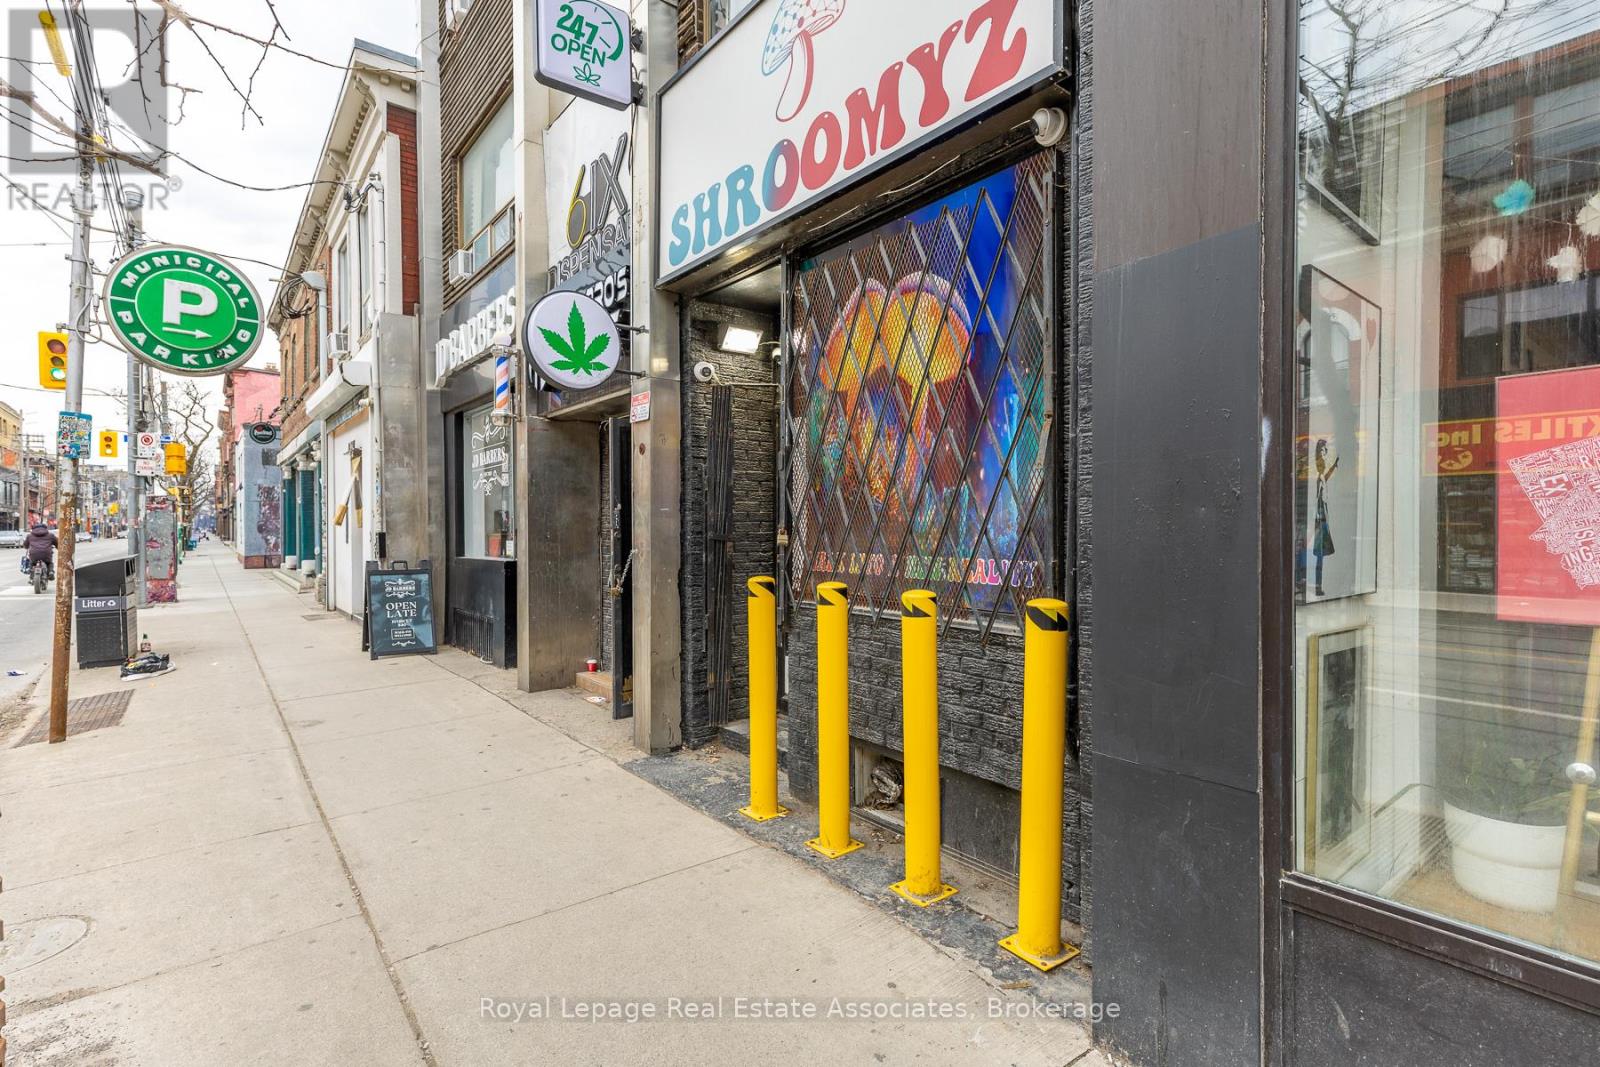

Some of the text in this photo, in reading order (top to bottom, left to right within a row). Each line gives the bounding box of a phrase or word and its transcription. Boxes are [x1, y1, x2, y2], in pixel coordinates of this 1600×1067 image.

[556, 3, 599, 46] 247
[550, 33, 606, 68] OPEN
[667, 0, 1028, 267] SHROOMYZ
[120, 254, 250, 308] MUNICIPAL
[162, 277, 219, 326] P
[116, 310, 252, 366] PARKING
[82, 599, 106, 608] Litter
[386, 601, 417, 611] OPEN
[387, 609, 417, 618] LATE
